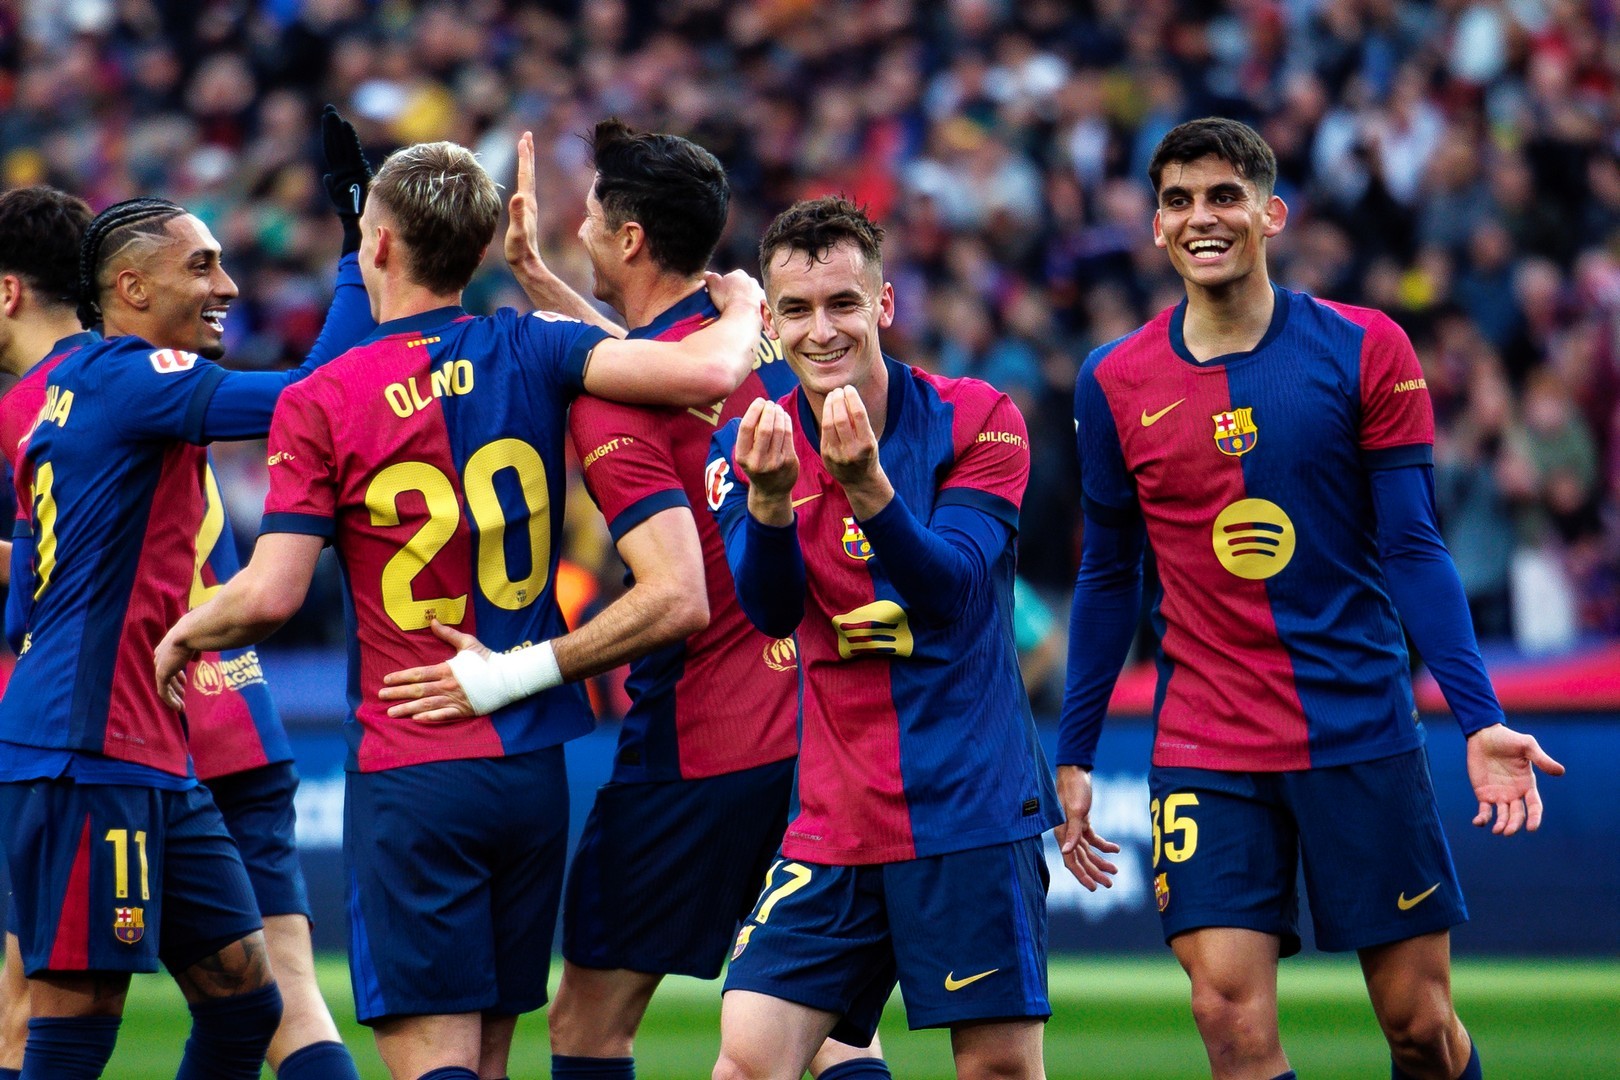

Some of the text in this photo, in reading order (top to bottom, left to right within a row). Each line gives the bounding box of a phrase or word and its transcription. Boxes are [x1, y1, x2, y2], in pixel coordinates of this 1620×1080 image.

[364, 438, 551, 631] 20
[105, 829, 150, 901] 11
[1151, 793, 1199, 869] 35
